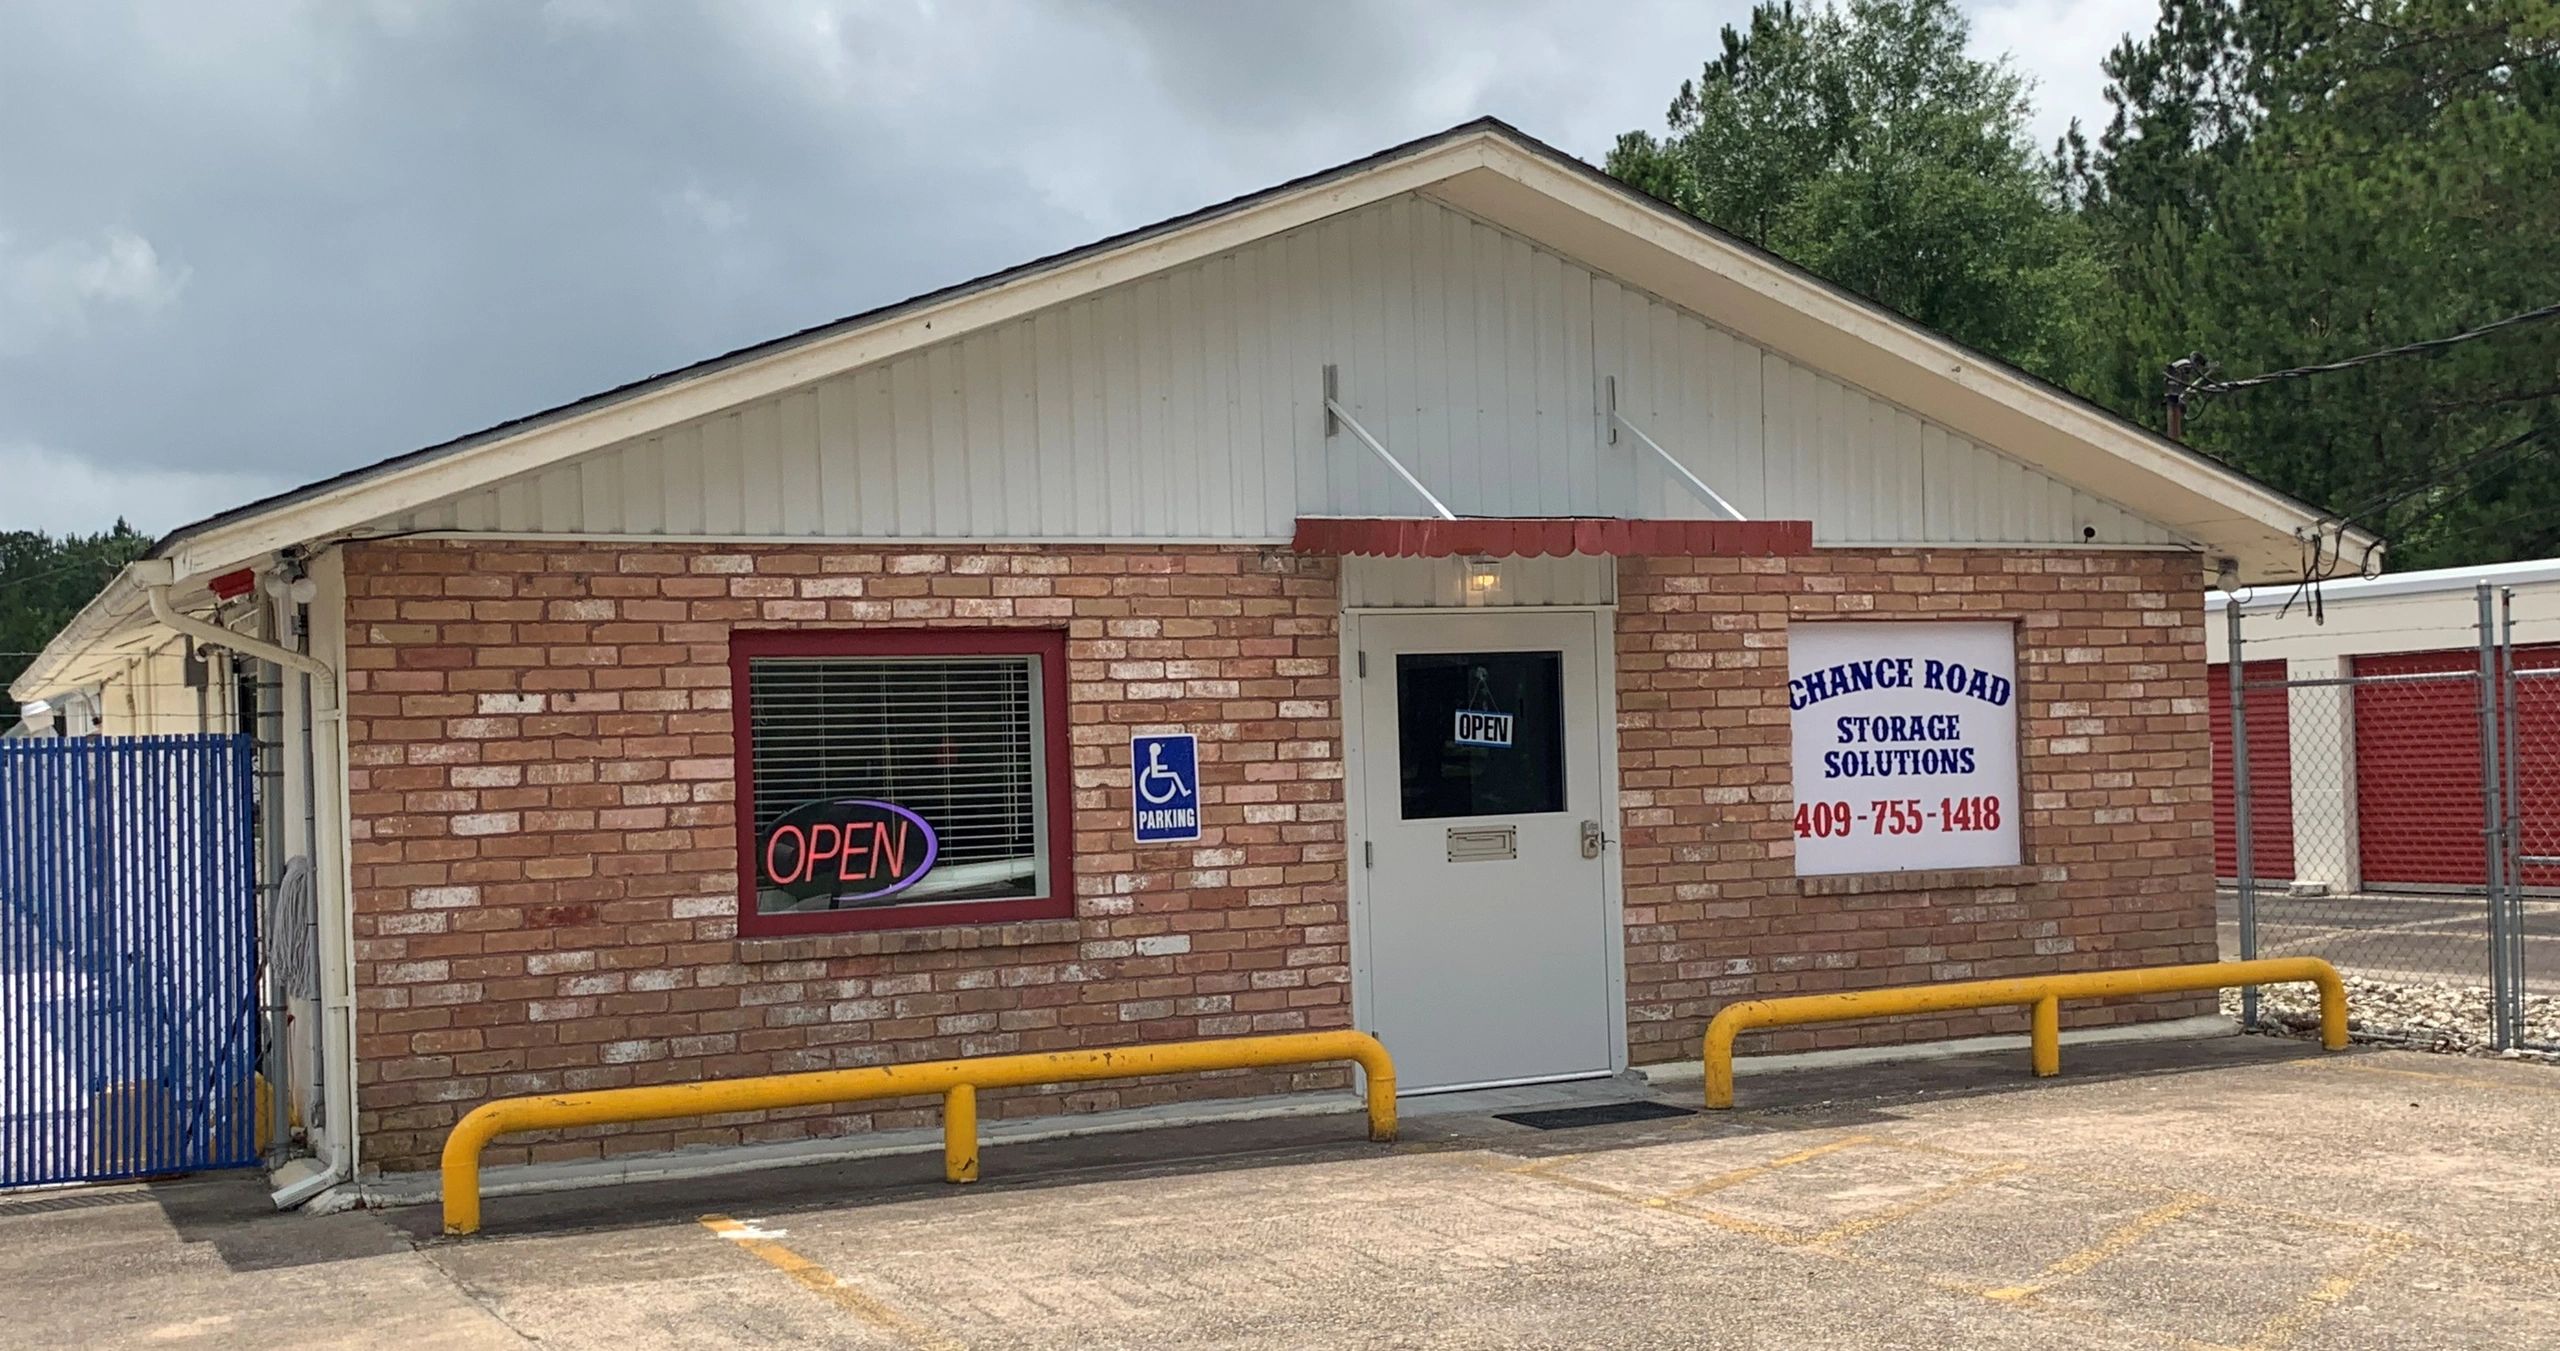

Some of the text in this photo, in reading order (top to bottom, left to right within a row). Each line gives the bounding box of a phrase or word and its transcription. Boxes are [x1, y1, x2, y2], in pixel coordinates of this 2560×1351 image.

[1788, 658, 2011, 710] CHANCE ROAD
[1459, 713, 1508, 742] OPEN
[1837, 714, 1960, 743] STORAGE
[1824, 747, 1975, 778] SOLUTIONS
[1139, 808, 1195, 830] PARKING
[767, 821, 908, 884] OPEN
